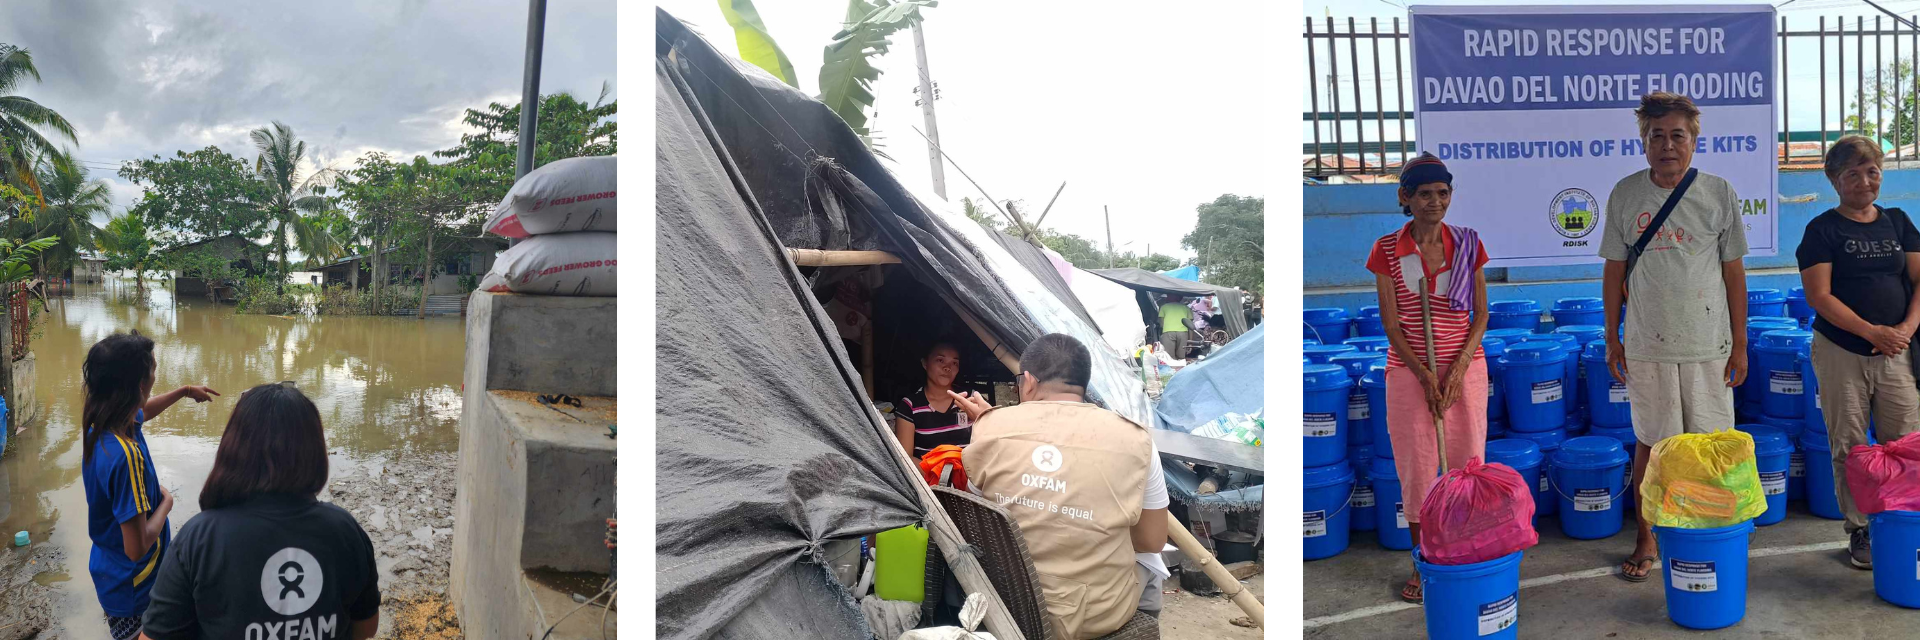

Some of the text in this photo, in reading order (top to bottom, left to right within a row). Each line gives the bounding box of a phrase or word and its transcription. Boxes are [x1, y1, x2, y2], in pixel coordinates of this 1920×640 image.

[1464, 27, 1725, 57] RAPID RESPONSE FOR
[1424, 75, 1505, 104] DAVAO
[1512, 75, 1558, 103] DEL
[1563, 74, 1641, 102] NORTE
[1438, 140, 1583, 160] DISTRIBUTION
[1589, 139, 1615, 157] OF
[1713, 135, 1758, 153] KITS
[550, 196, 576, 207] FEEDS
[577, 191, 616, 203] GROWER
[1845, 239, 1901, 253] GUESS
[538, 267, 563, 277] FEEDS
[564, 261, 603, 272] GROWER
[1021, 473, 1067, 494] OXFAM
[995, 492, 1011, 504] The
[1048, 501, 1059, 513] is
[1061, 505, 1093, 521] equal
[245, 613, 337, 640] OXFAM
